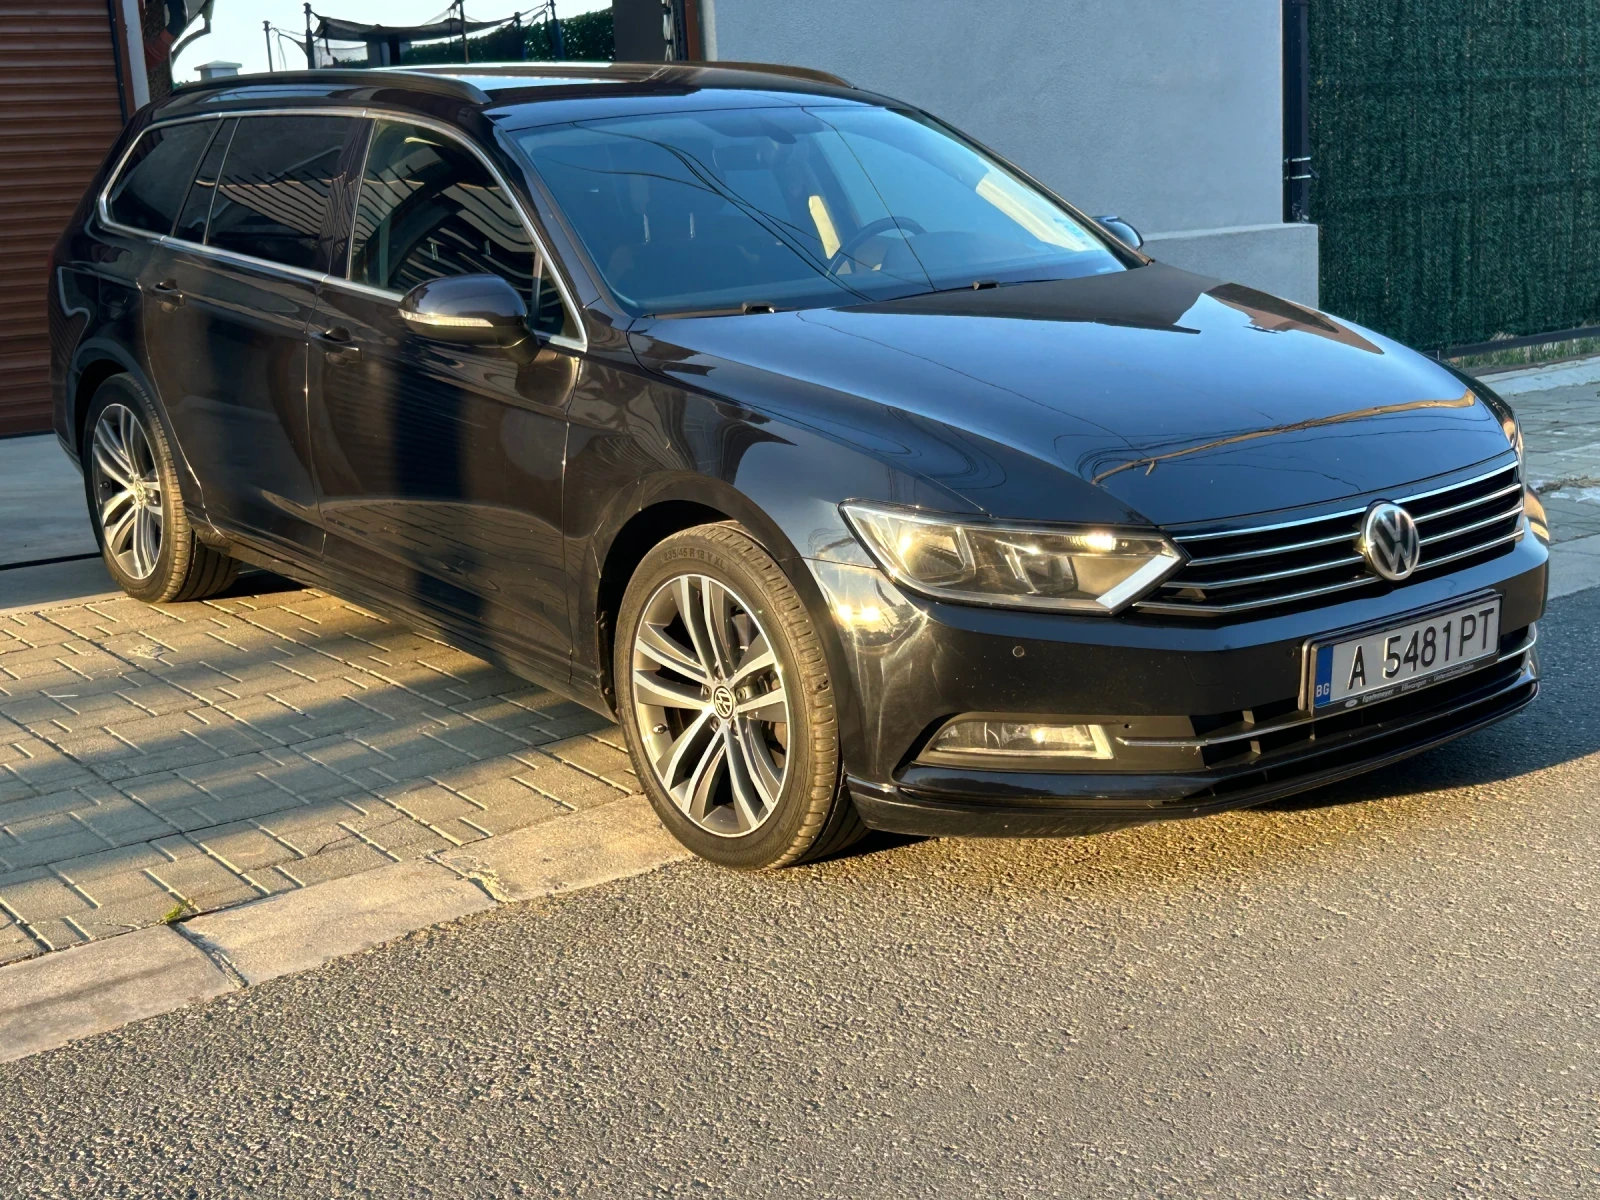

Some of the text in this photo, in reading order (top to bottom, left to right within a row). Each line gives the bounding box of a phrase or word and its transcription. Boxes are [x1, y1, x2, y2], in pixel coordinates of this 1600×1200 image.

[1366, 503, 1420, 581] VW
[1316, 682, 1330, 698] BG
[1346, 644, 1366, 690] A
